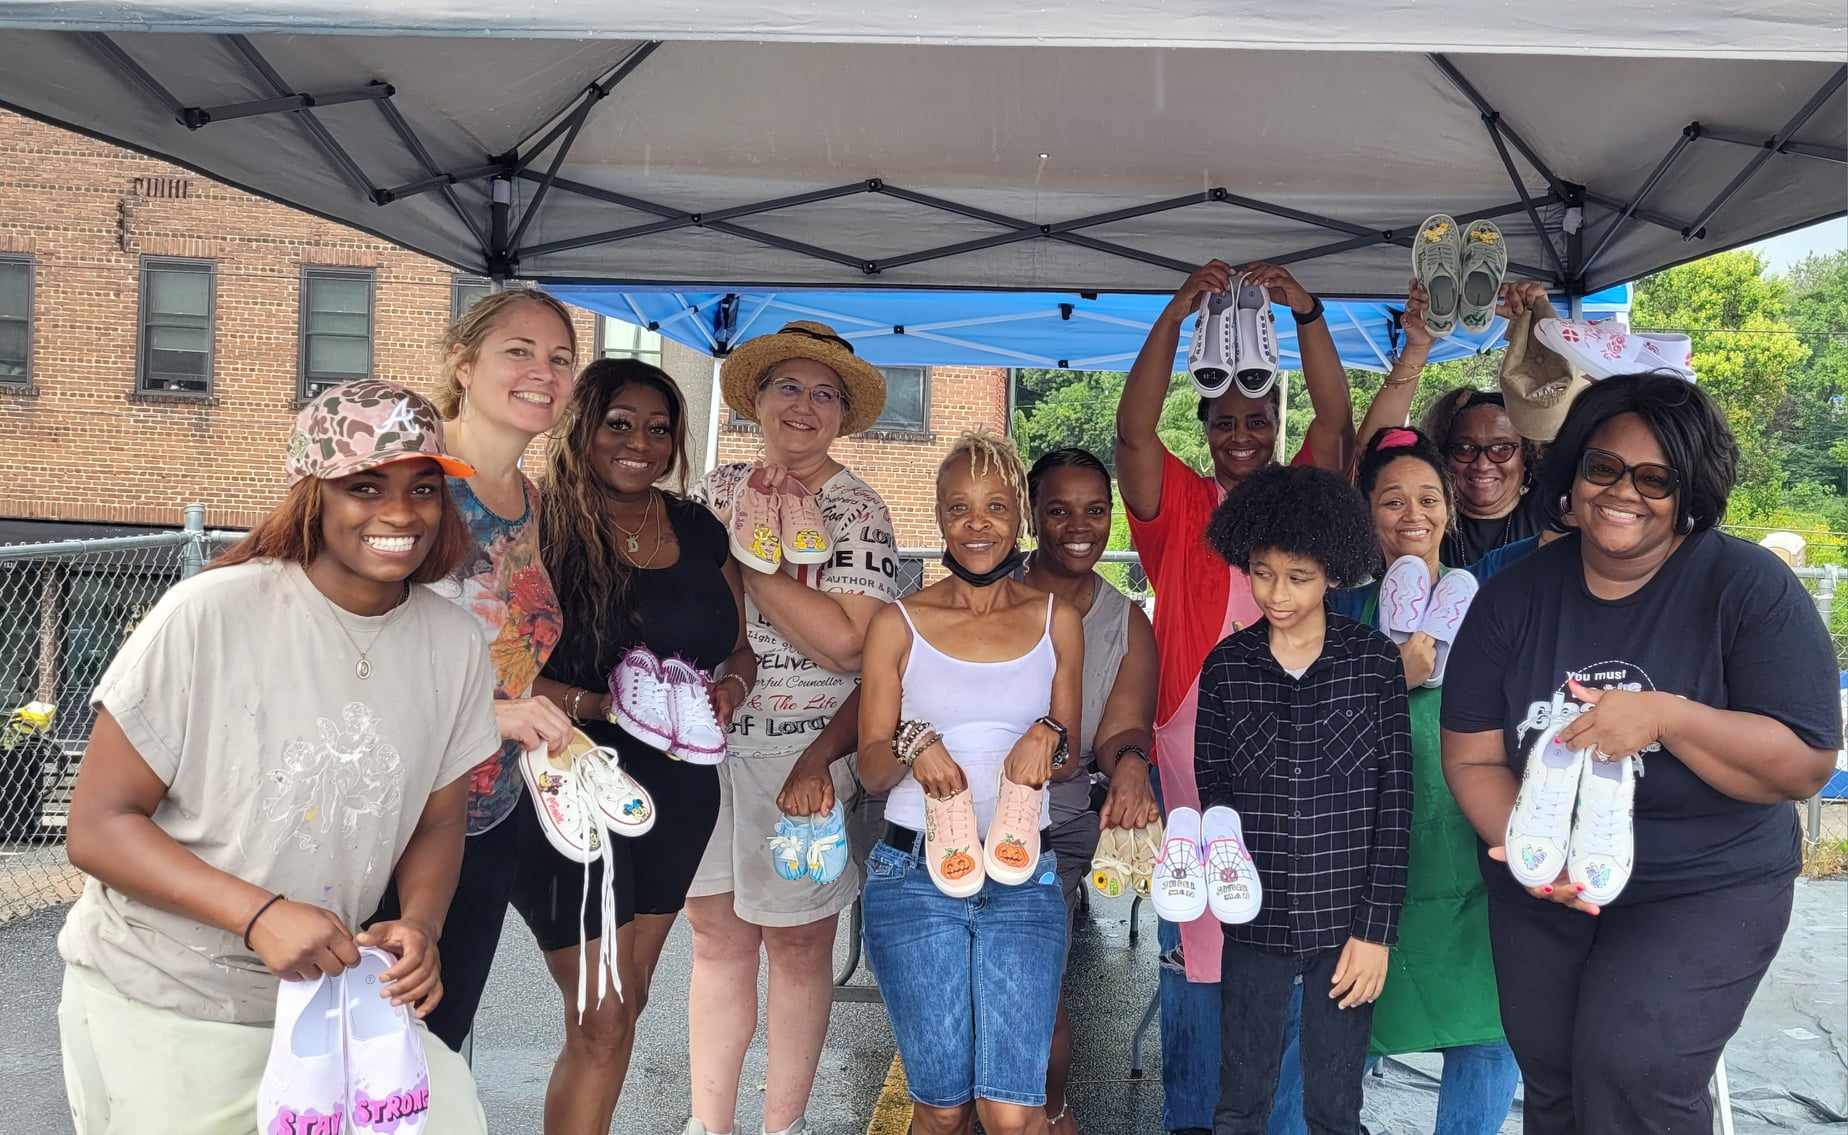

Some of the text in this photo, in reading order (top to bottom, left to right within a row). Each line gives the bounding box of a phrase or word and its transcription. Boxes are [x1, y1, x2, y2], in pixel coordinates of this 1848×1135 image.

[826, 575, 876, 588] AUTHOR
[748, 630, 777, 645] Light
[755, 653, 819, 670] DELIVE
[1567, 670, 1627, 682] You must
[768, 695, 798, 712] The
